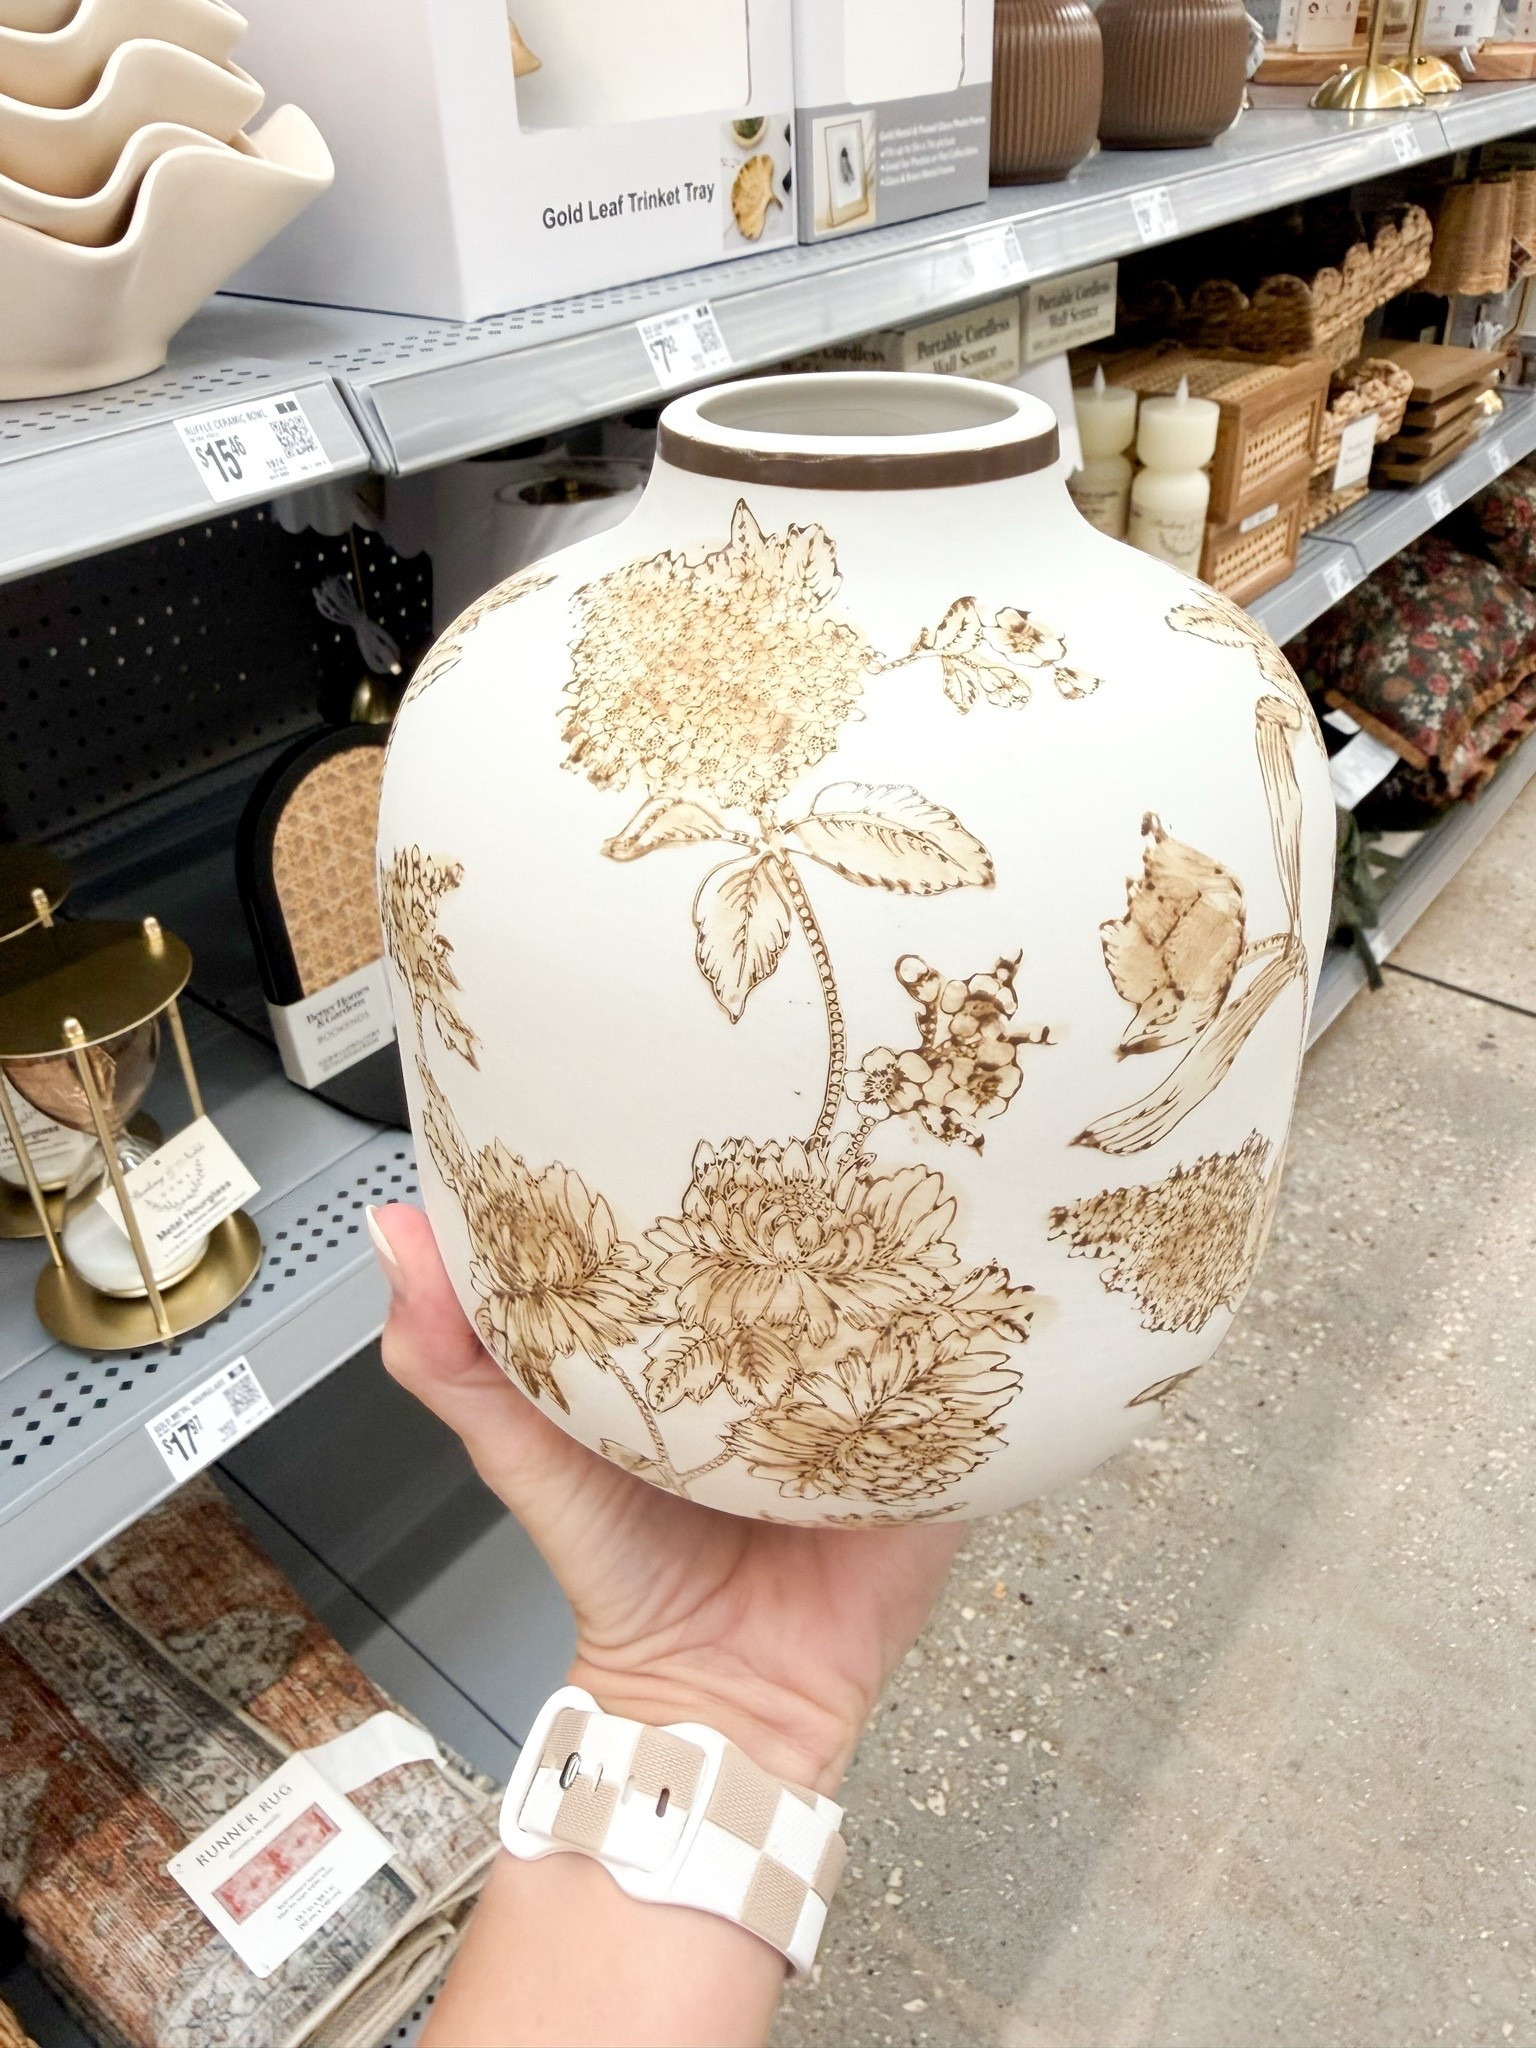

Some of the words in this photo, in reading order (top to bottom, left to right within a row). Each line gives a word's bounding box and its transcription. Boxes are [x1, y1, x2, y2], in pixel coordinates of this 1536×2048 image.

[542, 202, 583, 229] Gold
[588, 194, 624, 221] Leaf
[628, 186, 681, 213] Trinket
[684, 182, 715, 203] Tray
[917, 329, 962, 361] Portable
[965, 317, 1010, 343] Cordless
[213, 413, 246, 430] CERAMIC
[246, 409, 268, 421] BOWL
[336, 985, 370, 1007] Homes
[326, 998, 366, 1023] Gardens
[156, 1216, 185, 1241] Metal
[195, 1813, 260, 1867] RUNNER
[259, 1783, 294, 1813] RUG
